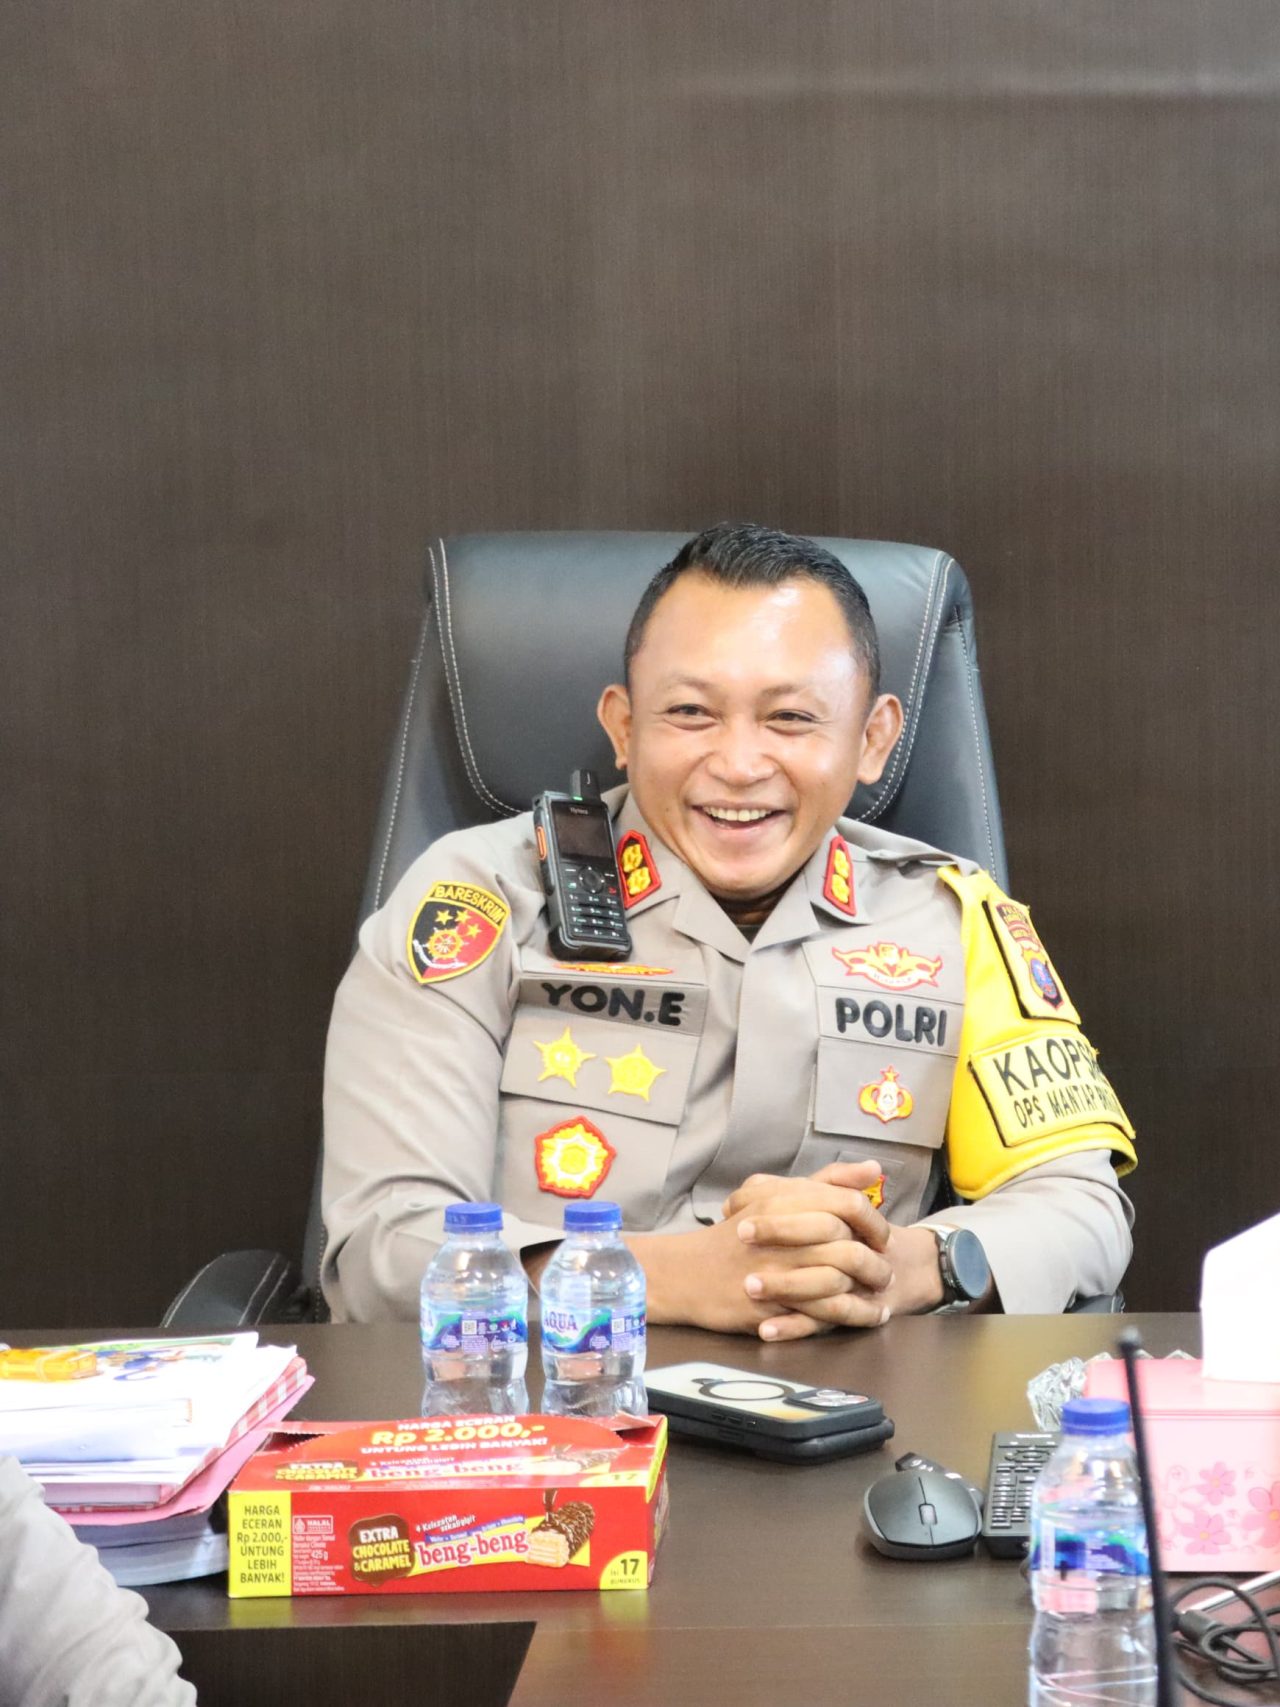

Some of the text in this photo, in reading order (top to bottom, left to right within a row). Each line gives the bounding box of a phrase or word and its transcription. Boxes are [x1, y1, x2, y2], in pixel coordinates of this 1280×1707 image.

[434, 885, 506, 924] BARESKRIM
[541, 982, 686, 1026] YON.E
[835, 997, 948, 1047] POLRI
[1013, 1095, 1046, 1129] OPS
[371, 1422, 545, 1446] Rp 2.000,-
[244, 1505, 280, 1516] HARGA
[242, 1518, 282, 1529] ECERAN
[237, 1532, 250, 1545] Rp
[252, 1532, 288, 1544] 2.000,-
[359, 1525, 399, 1544] EXTRA
[240, 1546, 285, 1557] UNTUNG
[352, 1539, 410, 1559] CHOCOLATE
[418, 1530, 529, 1567] beng-beng
[247, 1559, 277, 1570] LEBIH
[620, 1558, 640, 1575] 17
[240, 1572, 285, 1583] BANYAK!
